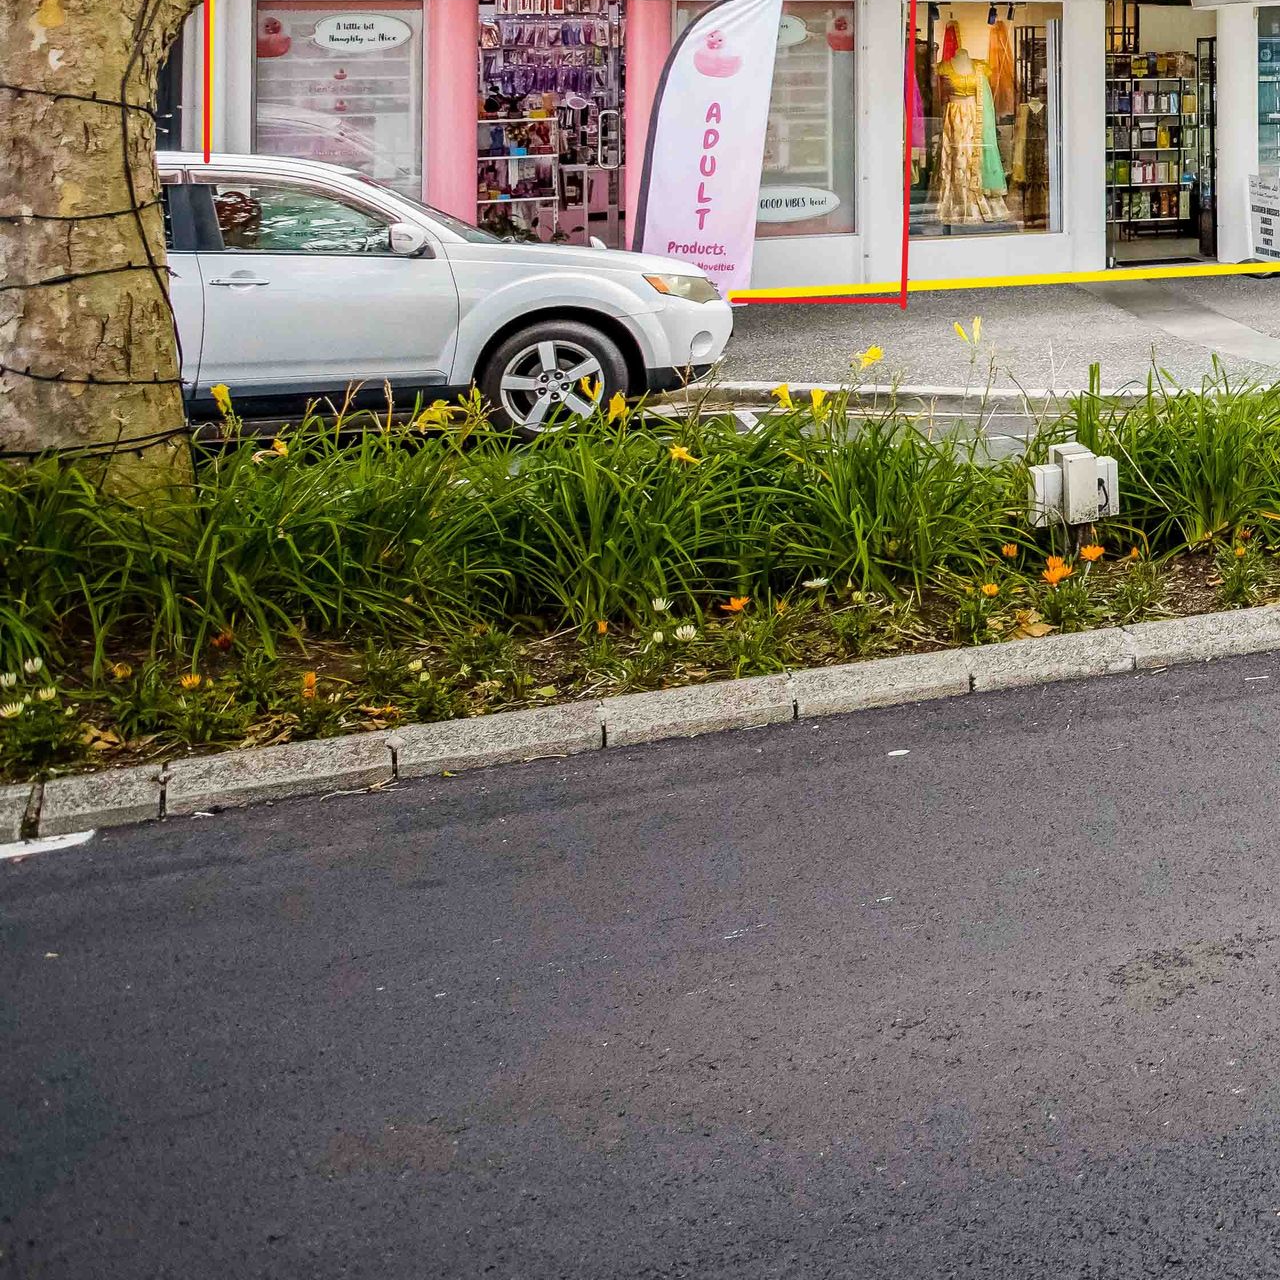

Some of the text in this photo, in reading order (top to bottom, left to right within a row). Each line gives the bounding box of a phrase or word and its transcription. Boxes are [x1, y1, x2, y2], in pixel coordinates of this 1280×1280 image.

[378, 33, 397, 42] Nice
[695, 102, 722, 231] ADULT
[760, 198, 783, 209] GOOD
[784, 196, 806, 208] VIBES
[667, 241, 727, 256] Products.
